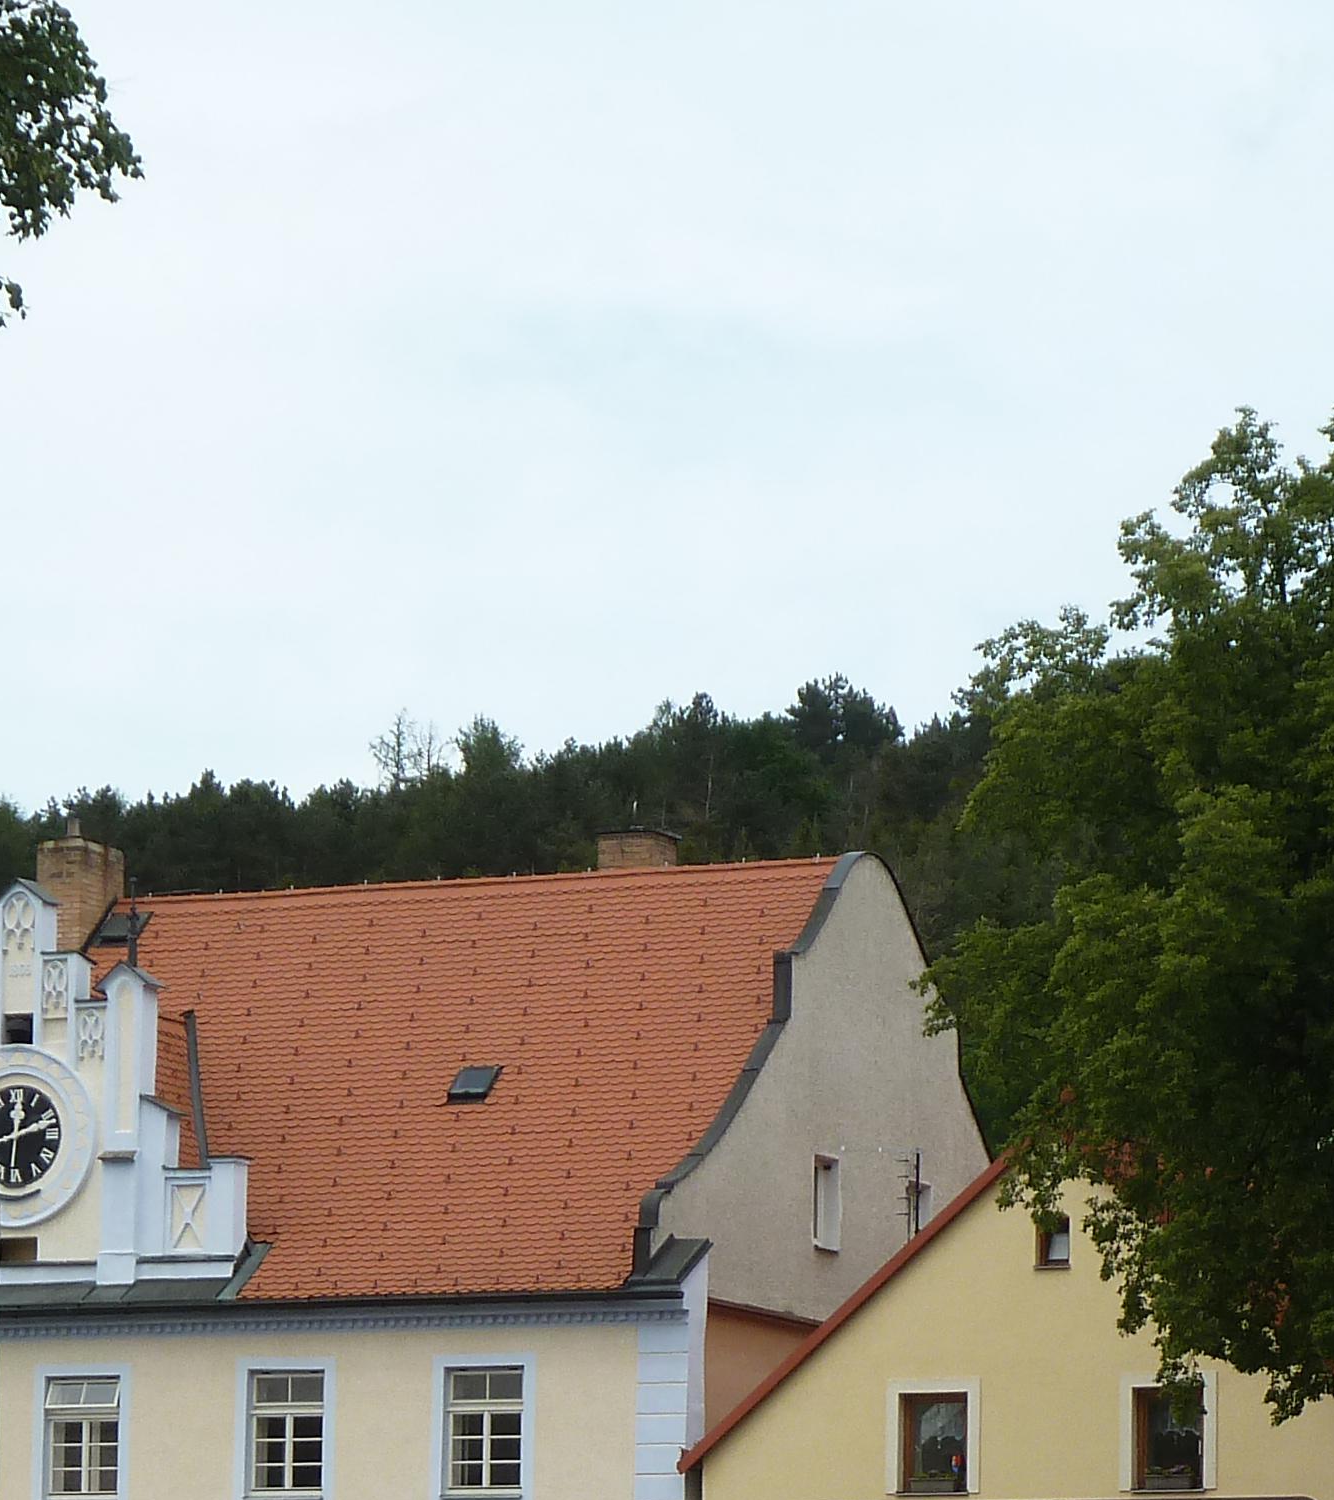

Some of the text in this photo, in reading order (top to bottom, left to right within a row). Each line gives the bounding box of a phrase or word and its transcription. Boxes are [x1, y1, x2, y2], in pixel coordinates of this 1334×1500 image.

[45, 1128, 59, 1139] III
[10, 1168, 22, 1182] VI
[30, 1163, 42, 1177] V
